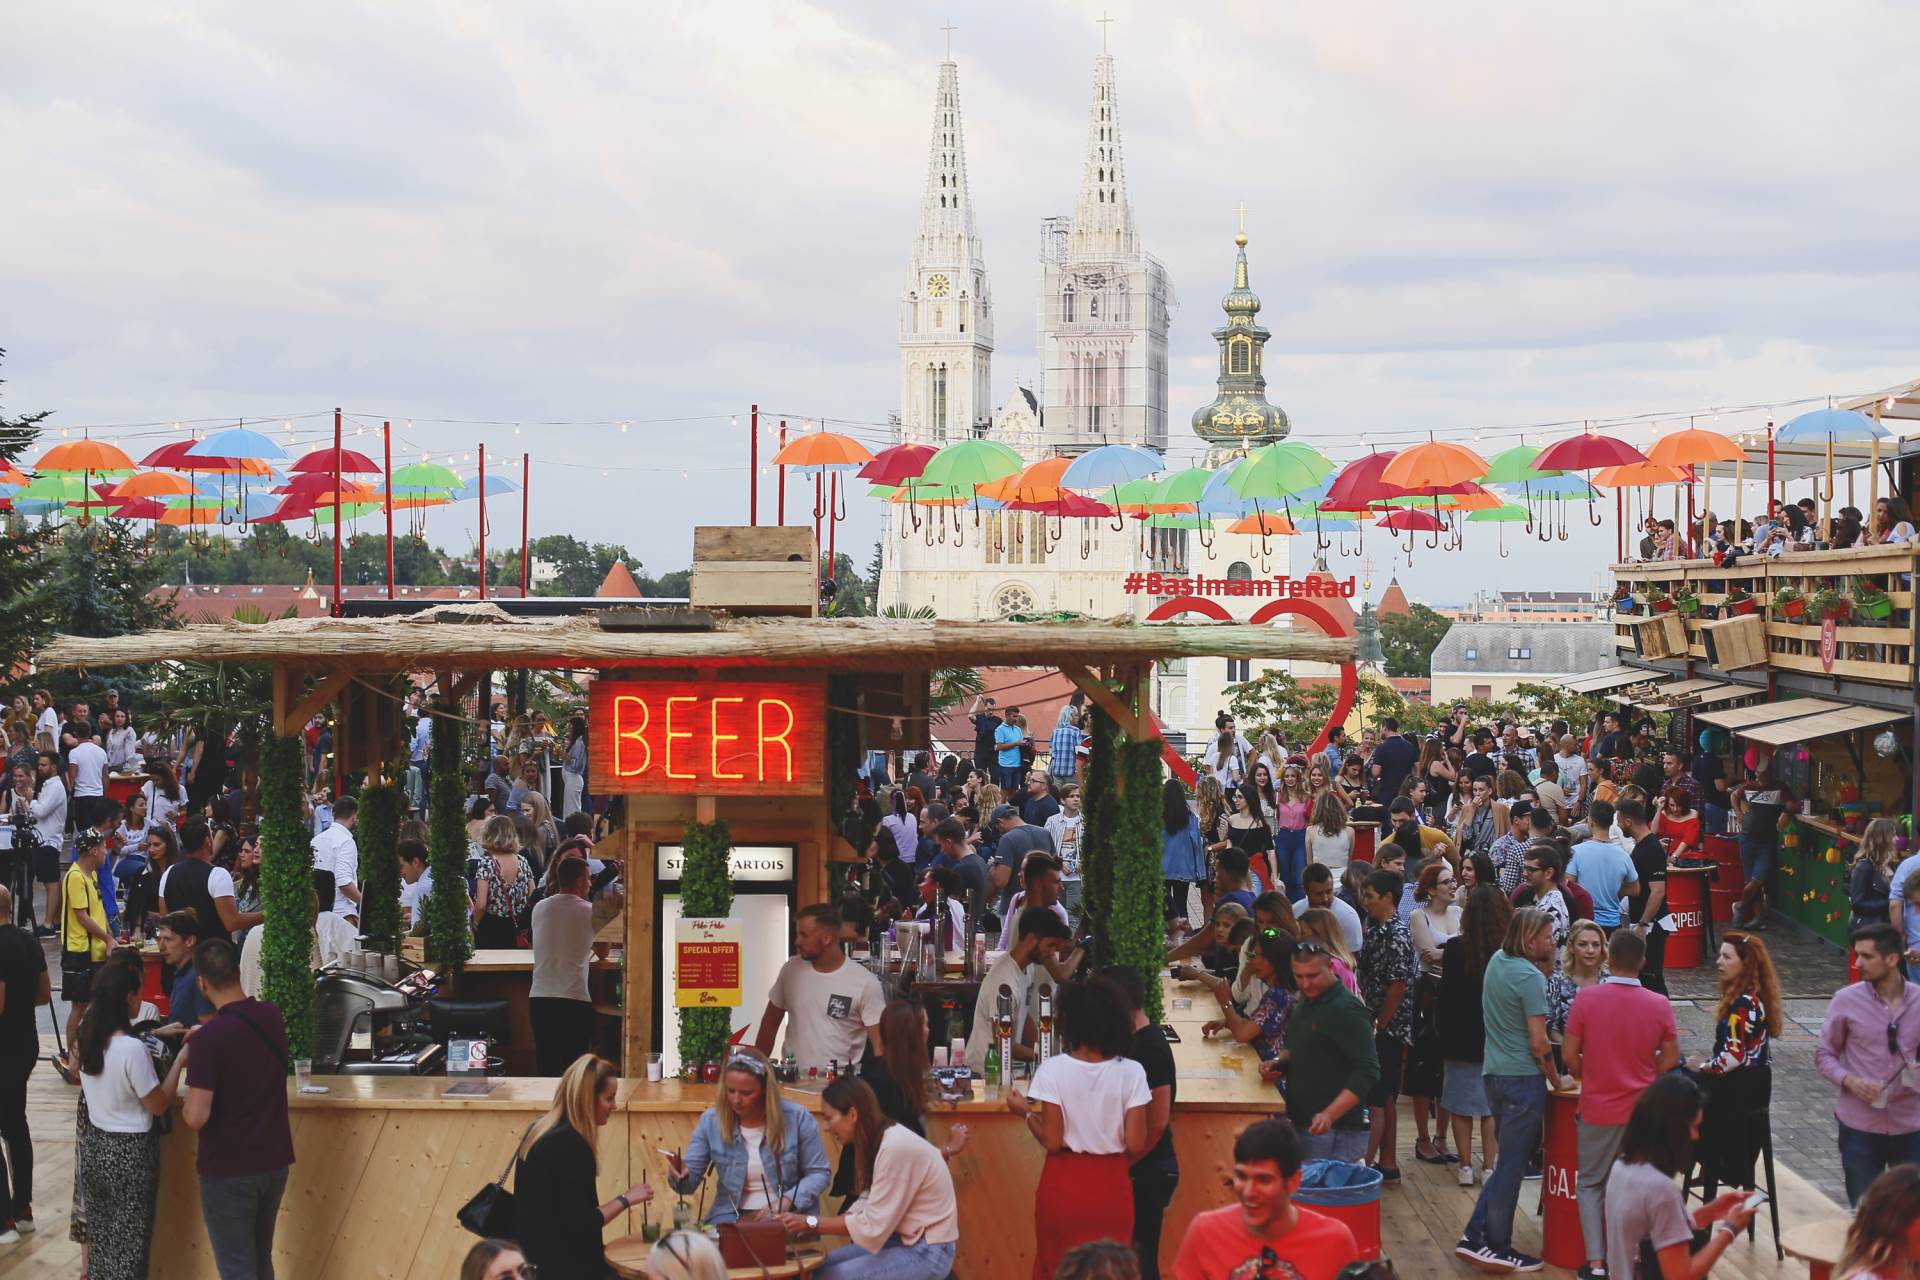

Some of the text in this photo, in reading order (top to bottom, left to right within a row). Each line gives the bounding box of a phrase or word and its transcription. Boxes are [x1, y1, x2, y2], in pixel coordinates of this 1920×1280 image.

[614, 695, 794, 782] BEER
[733, 860, 785, 871] ARTOIS
[683, 946, 735, 954] SPECIAL OFFER
